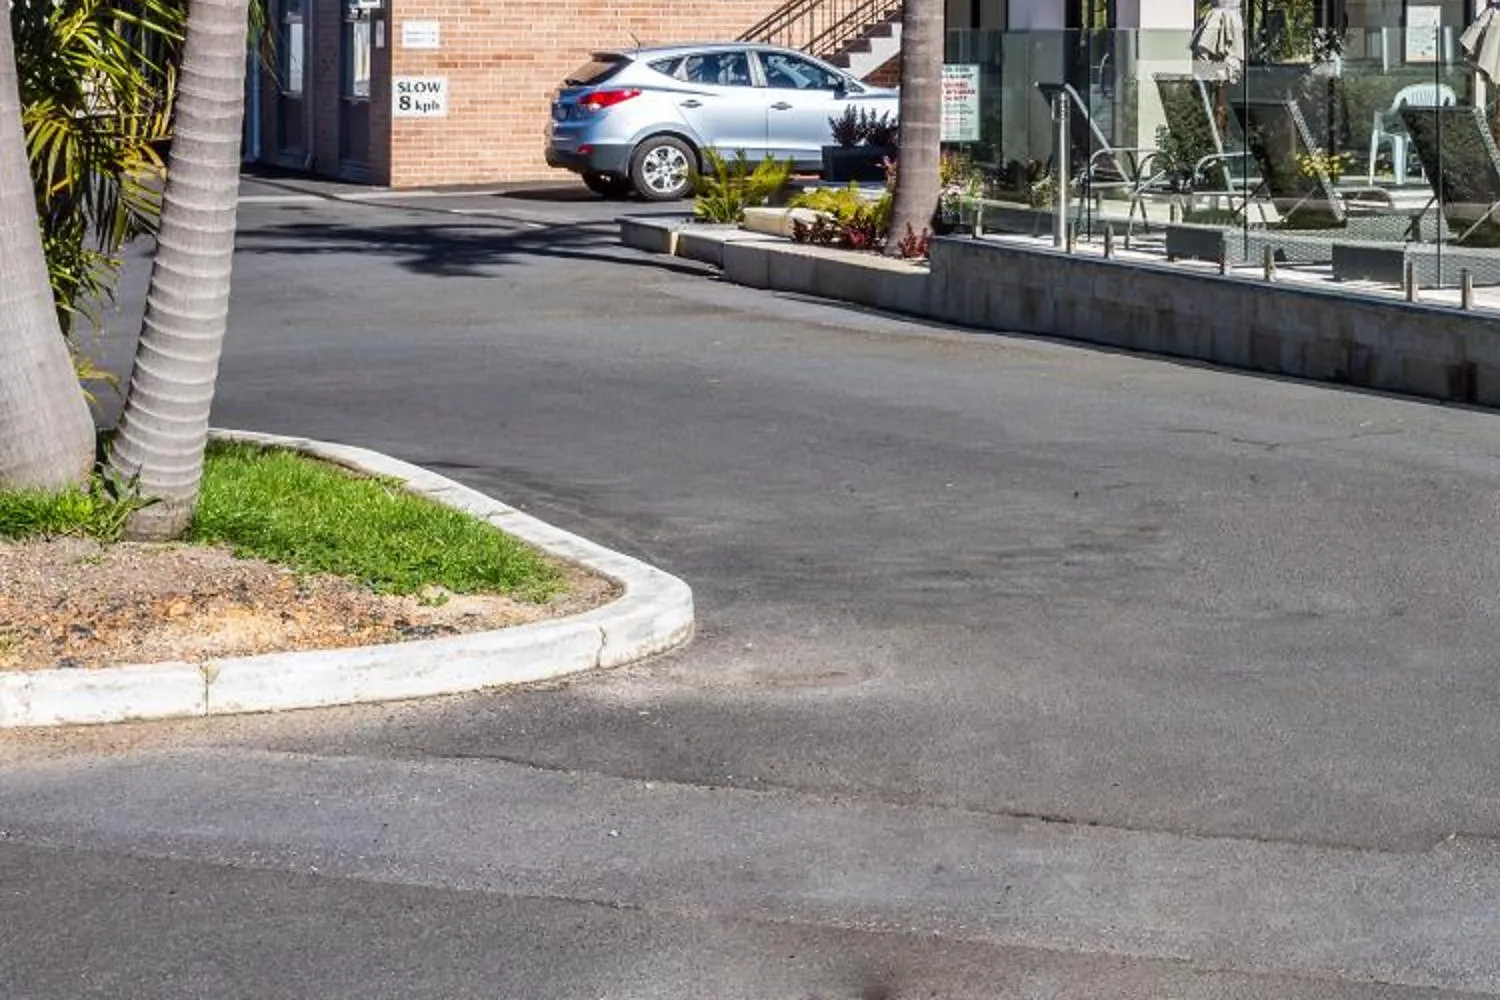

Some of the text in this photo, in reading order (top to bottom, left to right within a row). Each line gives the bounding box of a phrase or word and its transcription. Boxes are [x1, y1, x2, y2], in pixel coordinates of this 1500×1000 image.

[398, 81, 440, 93] SLOW
[399, 95, 440, 113] 8 kph
